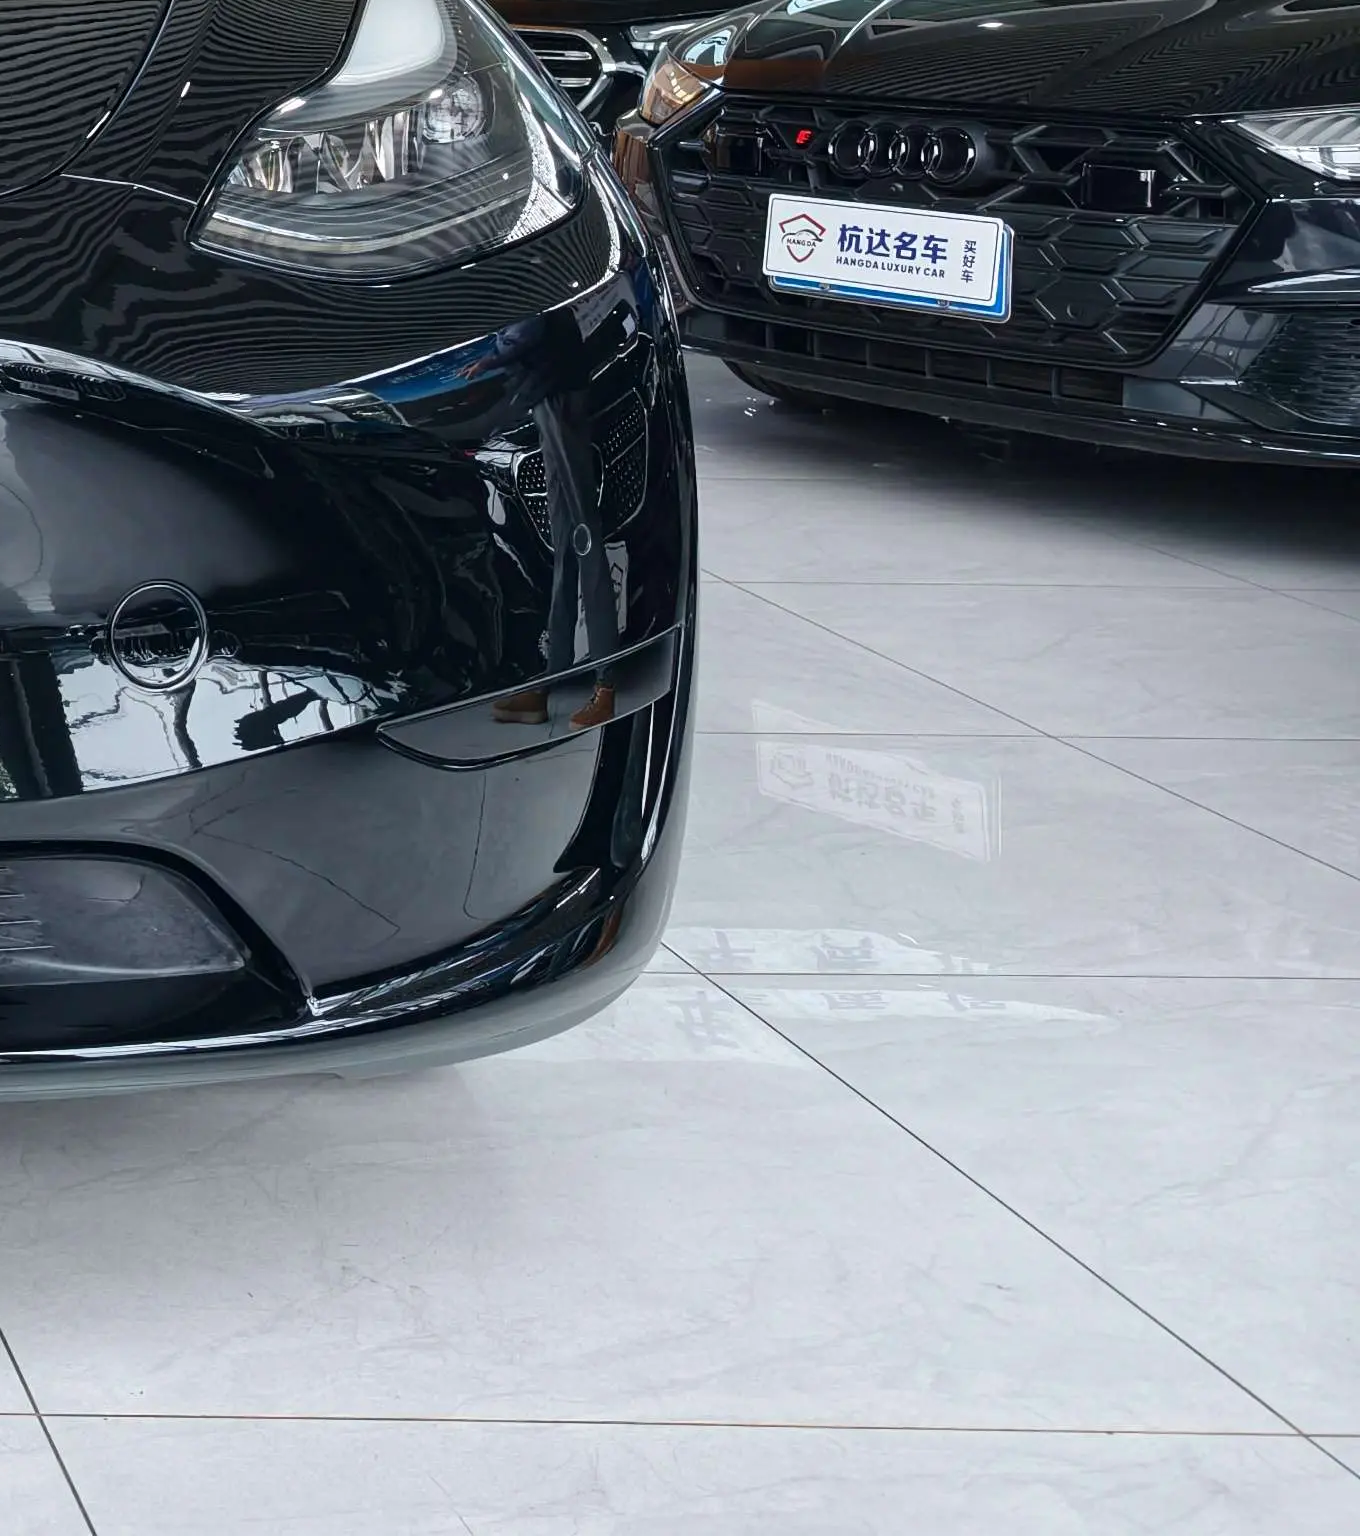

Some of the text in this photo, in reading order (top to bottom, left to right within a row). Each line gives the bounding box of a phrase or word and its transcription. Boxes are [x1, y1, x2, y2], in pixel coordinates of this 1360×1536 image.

[837, 223, 949, 265] 杭达名车
[960, 239, 978, 284] 买好车
[835, 255, 946, 279] HANGDA LUXURY CAR
